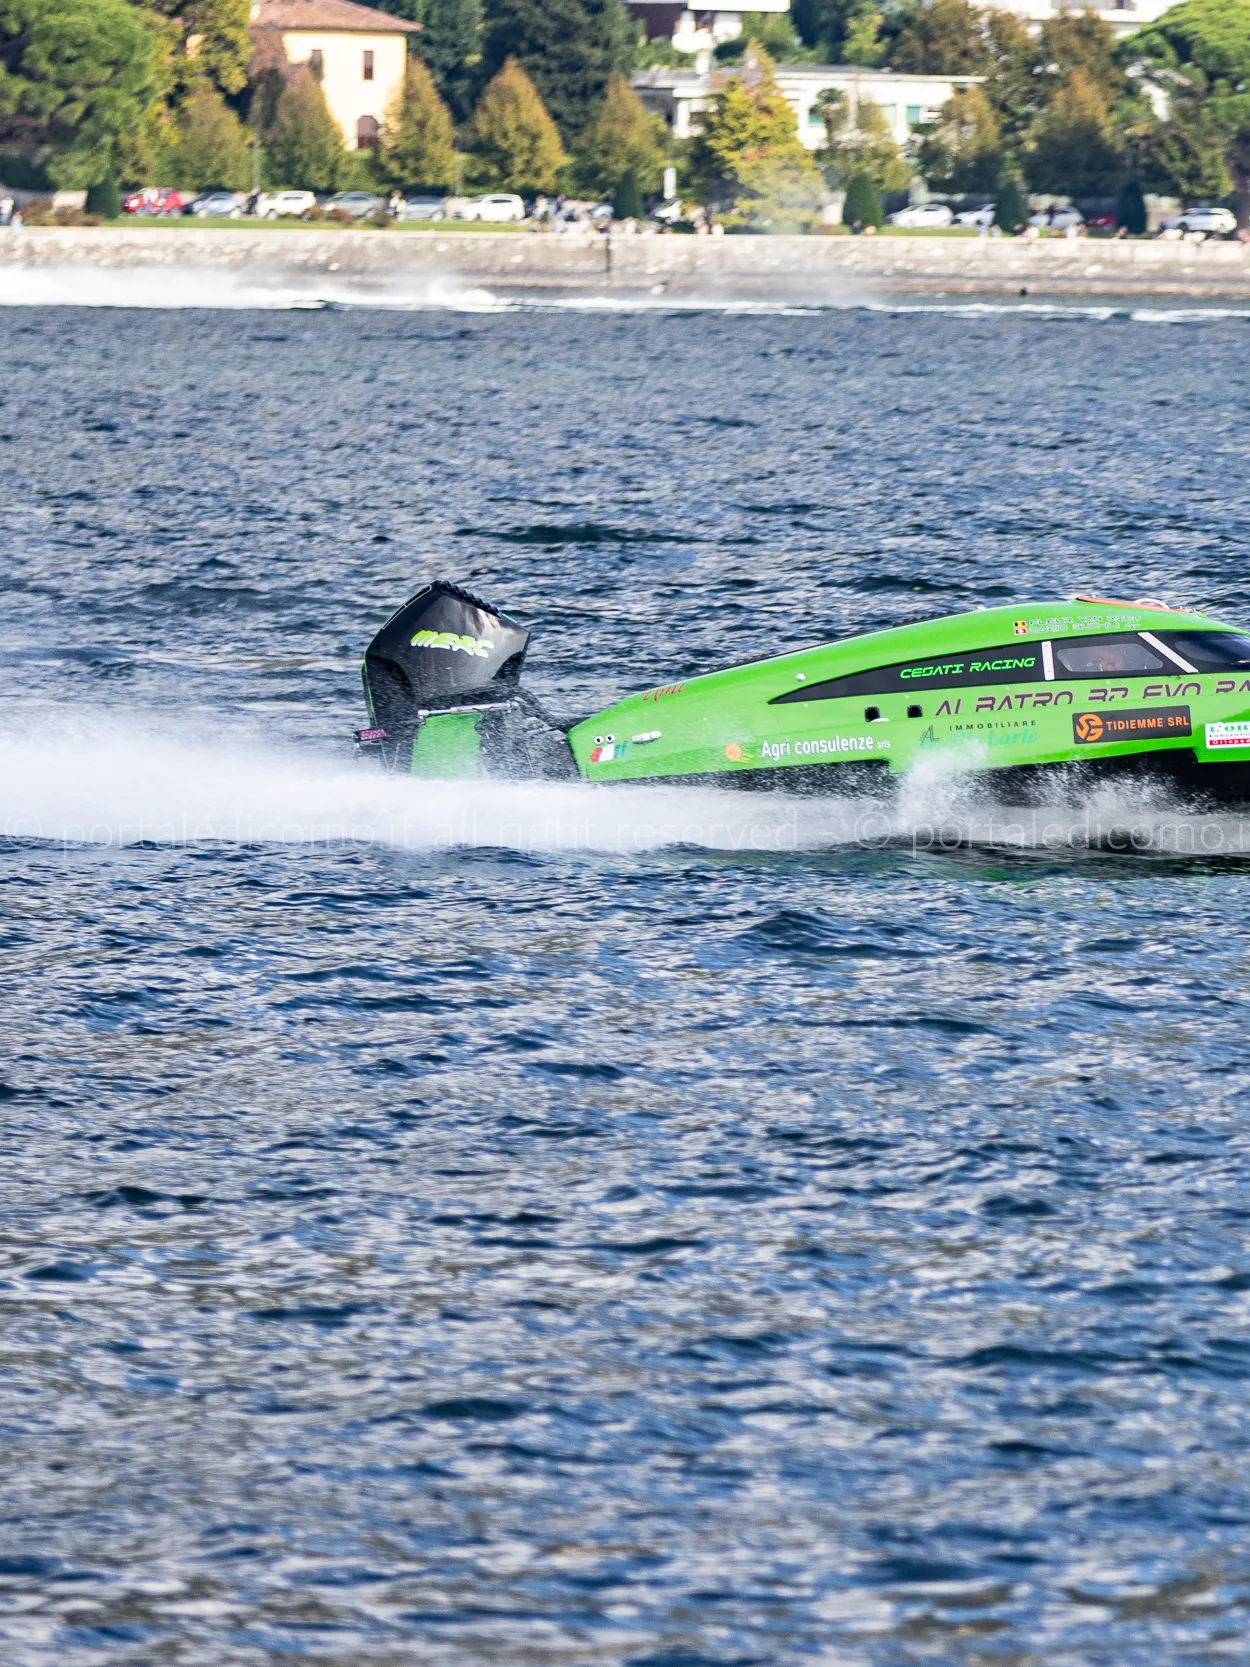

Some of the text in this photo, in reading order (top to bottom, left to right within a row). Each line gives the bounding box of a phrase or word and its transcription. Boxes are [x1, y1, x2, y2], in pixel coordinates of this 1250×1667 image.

[410, 629, 495, 658] MERC
[969, 657, 1036, 673] RACING
[949, 720, 1037, 731] IMMOBILIARE
[1105, 716, 1190, 731] TIDIEMME SRL
[988, 728, 1038, 746] Lario
[761, 738, 790, 761] Agri
[794, 735, 874, 755] consulenze
